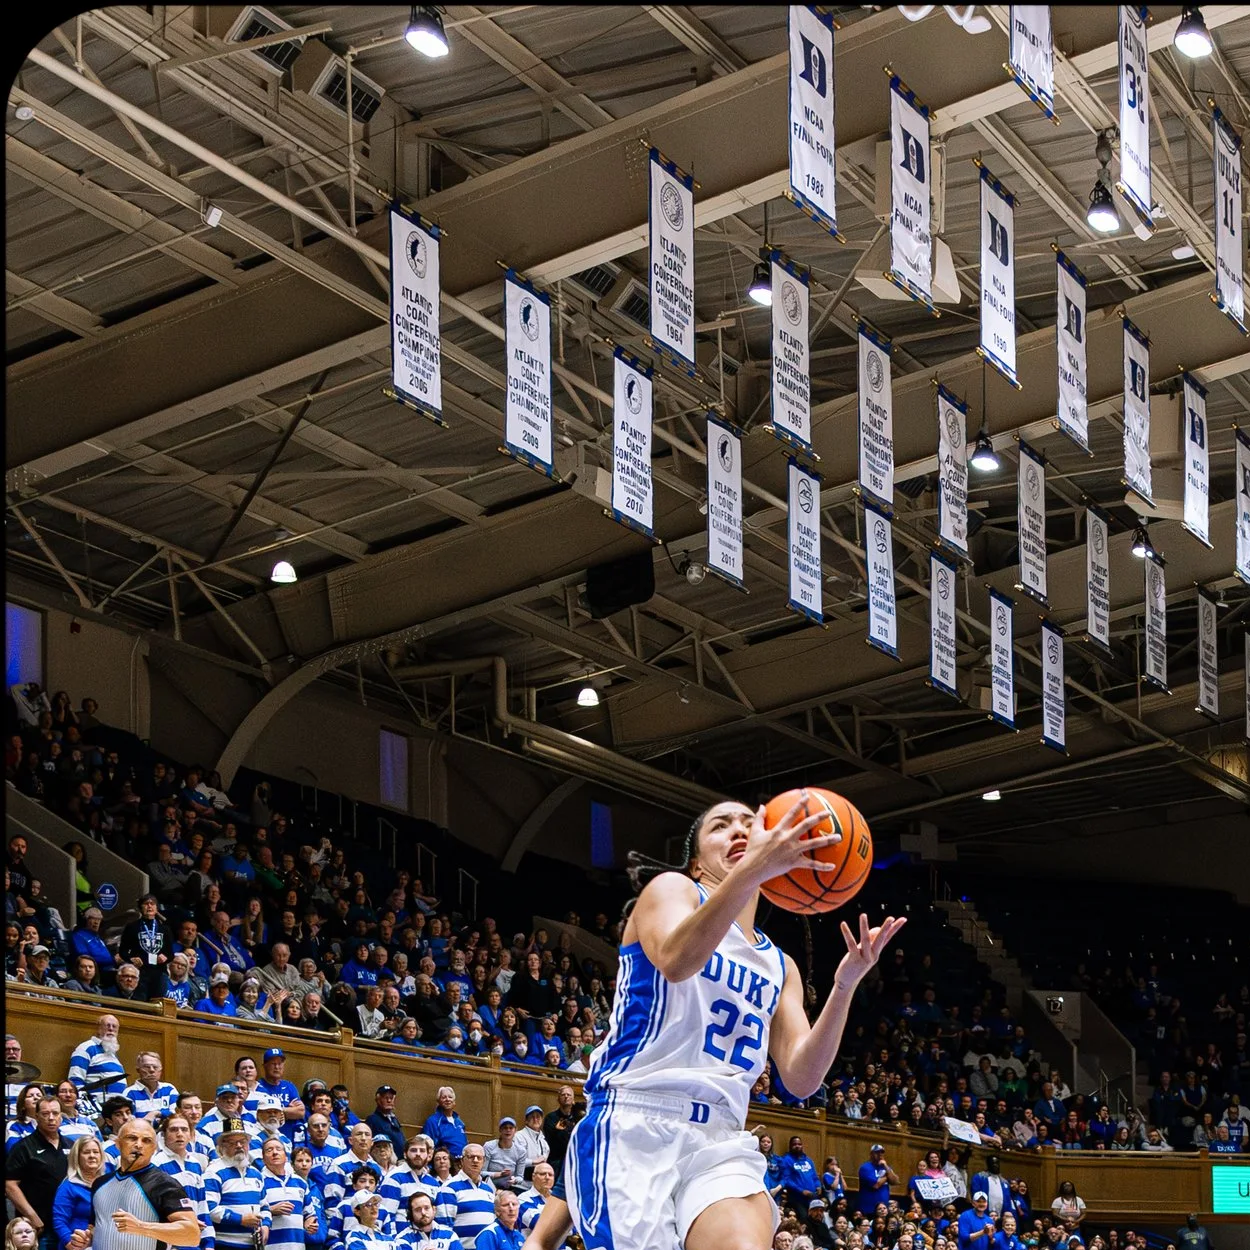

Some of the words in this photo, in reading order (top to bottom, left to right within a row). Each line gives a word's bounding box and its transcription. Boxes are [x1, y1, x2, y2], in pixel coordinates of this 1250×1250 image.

[804, 106, 824, 133] NCAA
[904, 191, 922, 217] NCAA
[663, 254, 683, 277] COAST
[654, 262, 693, 302] CONFERENCE
[401, 286, 433, 315] ATLANTIC
[655, 281, 692, 317] CHAMPIONS
[406, 304, 429, 325] COAST
[396, 313, 440, 350] CONFERENCE
[666, 324, 683, 346] 1964
[397, 331, 439, 365] CHAMPIONS
[514, 348, 544, 374] ATLANTIC
[783, 347, 801, 367] COAST
[520, 365, 540, 385] COAST
[776, 372, 810, 403] CHAMPIONS
[508, 376, 550, 408] CONFERENCE
[510, 392, 549, 422] CHAMPIONS
[522, 429, 539, 450] 2009
[625, 496, 644, 516] 2010
[702, 998, 764, 1072] 22
